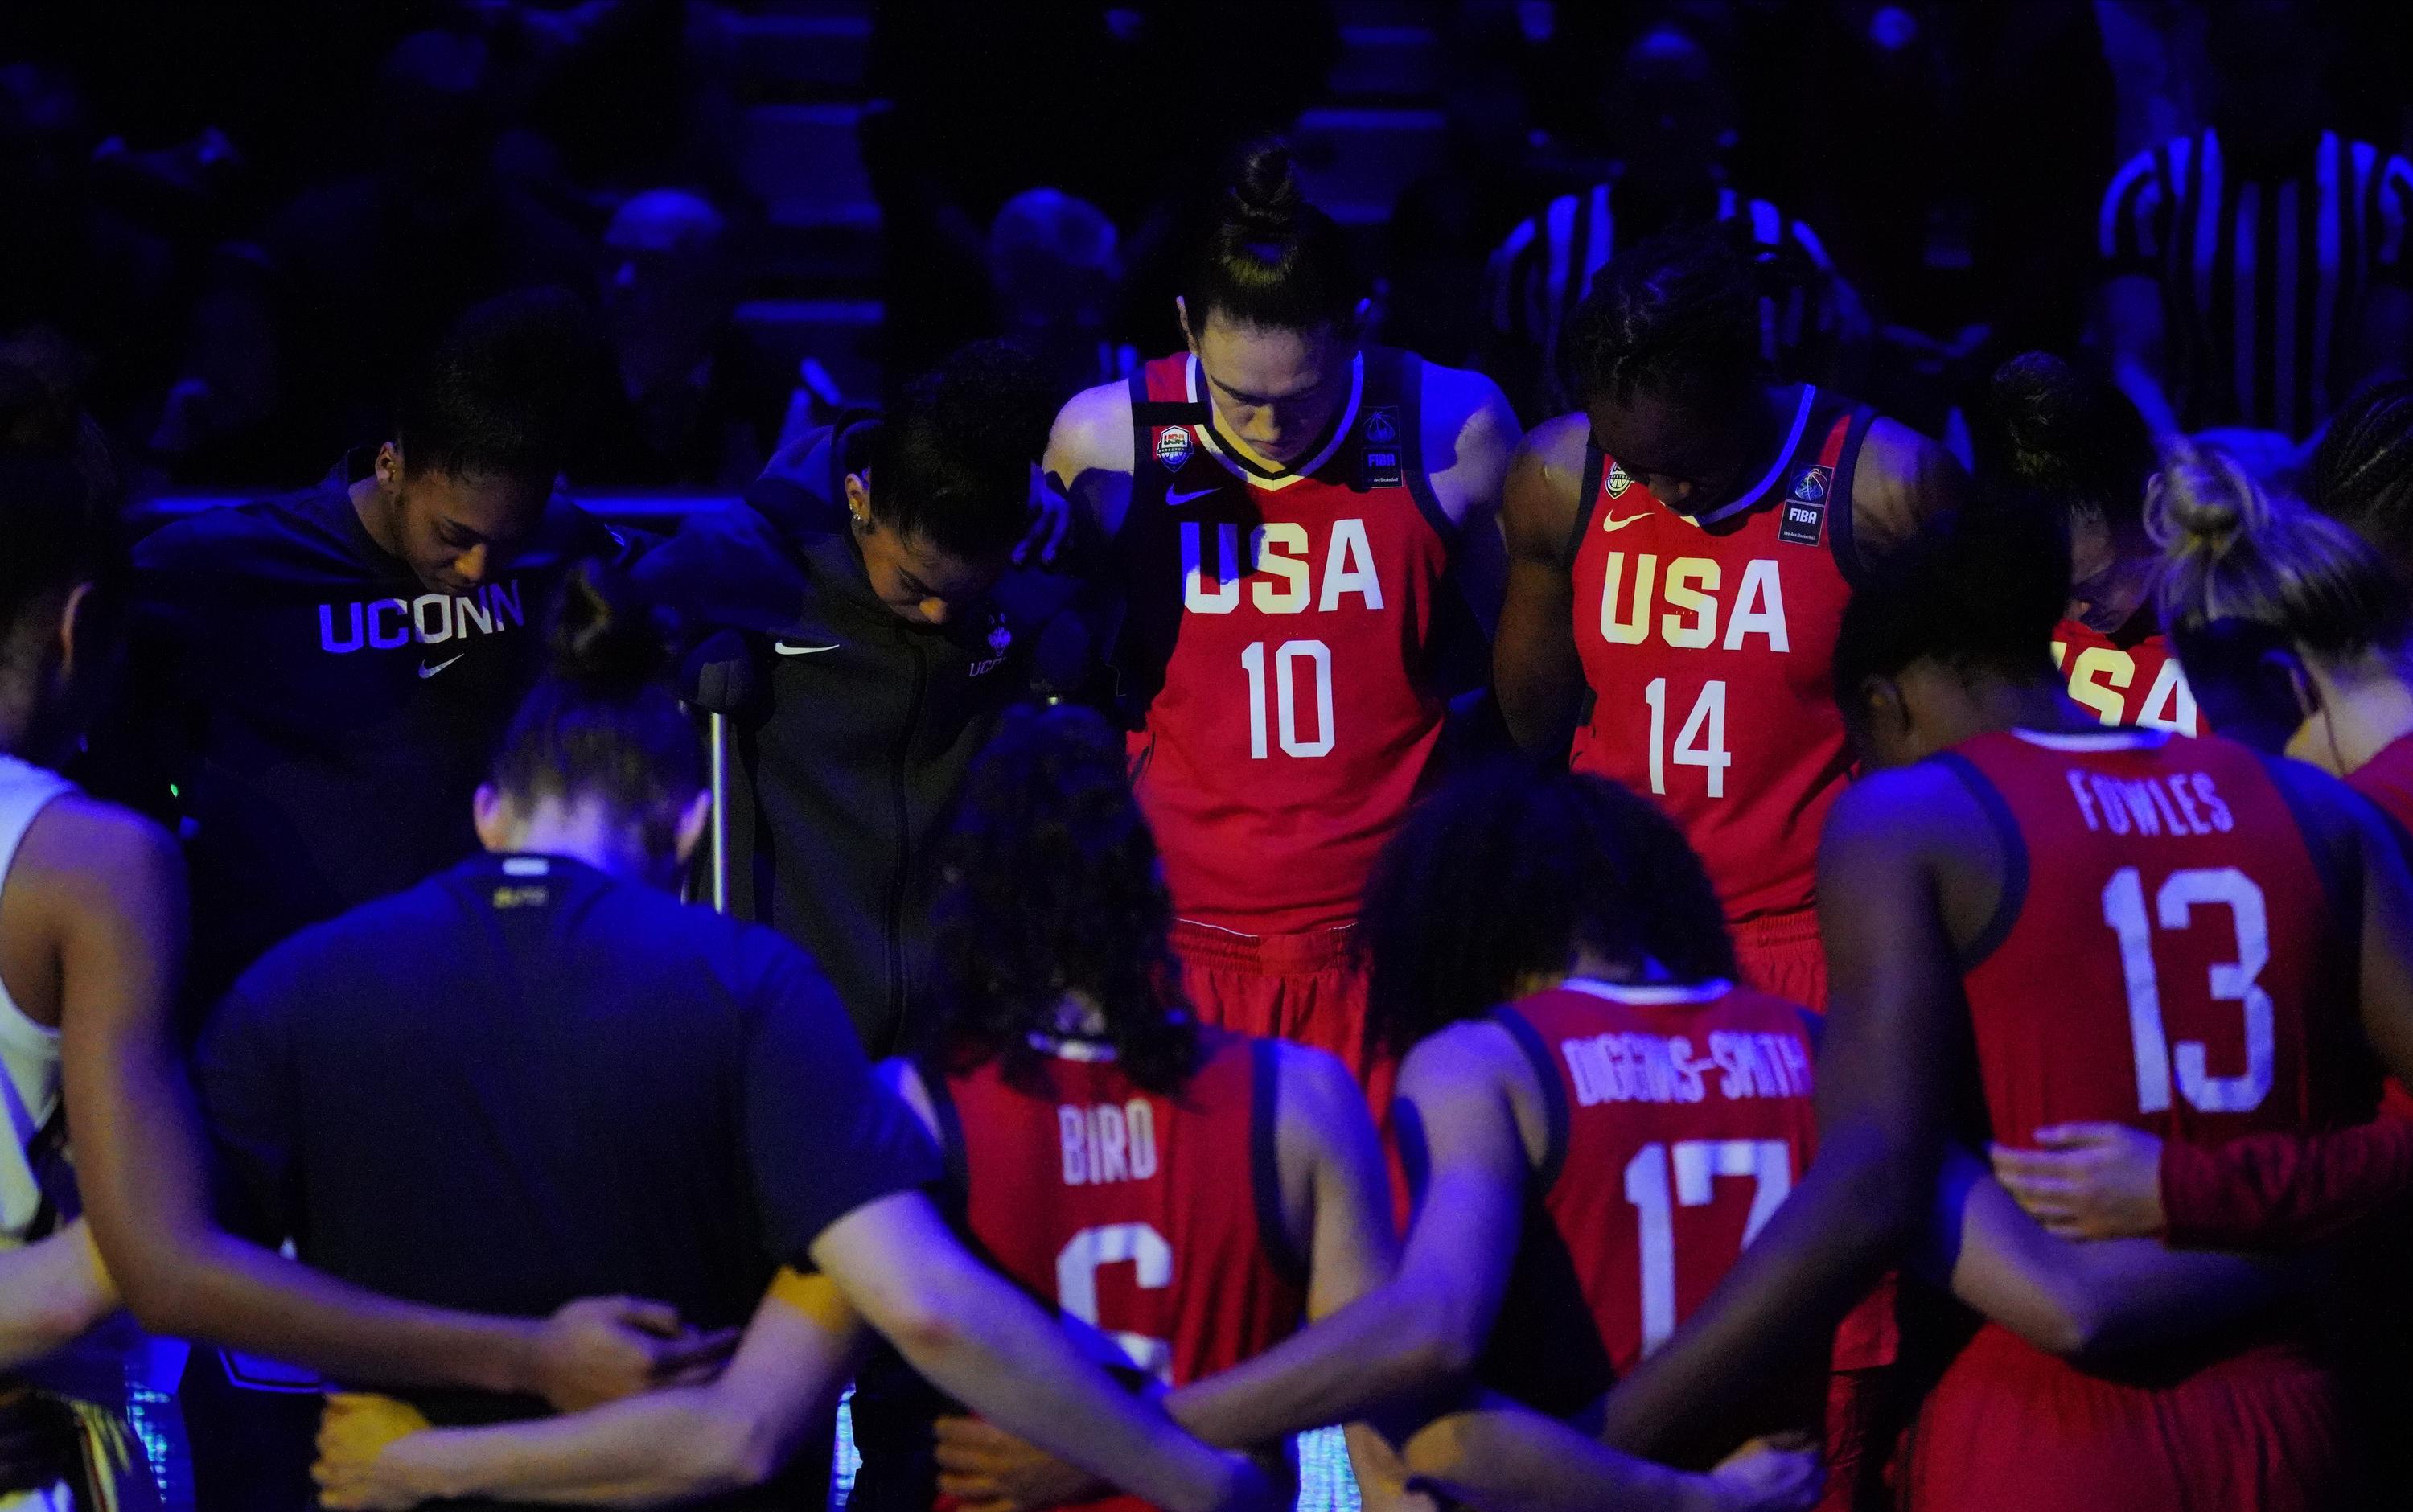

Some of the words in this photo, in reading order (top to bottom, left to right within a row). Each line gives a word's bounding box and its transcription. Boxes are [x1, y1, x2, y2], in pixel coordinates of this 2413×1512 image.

[1367, 454, 1396, 467] FIBA
[1788, 507, 1818, 524] FIBA
[1180, 519, 1384, 614] USA
[1600, 551, 1790, 653] USA
[318, 578, 526, 654] UCONN
[1241, 639, 1336, 760] 10
[1645, 677, 1732, 799] 14
[2049, 640, 2198, 740] SA
[2066, 768, 2235, 836] FOWLES
[2100, 865, 2276, 1116] 13
[1056, 1095, 1158, 1187] BIRD
[1622, 1138, 1793, 1362] 17
